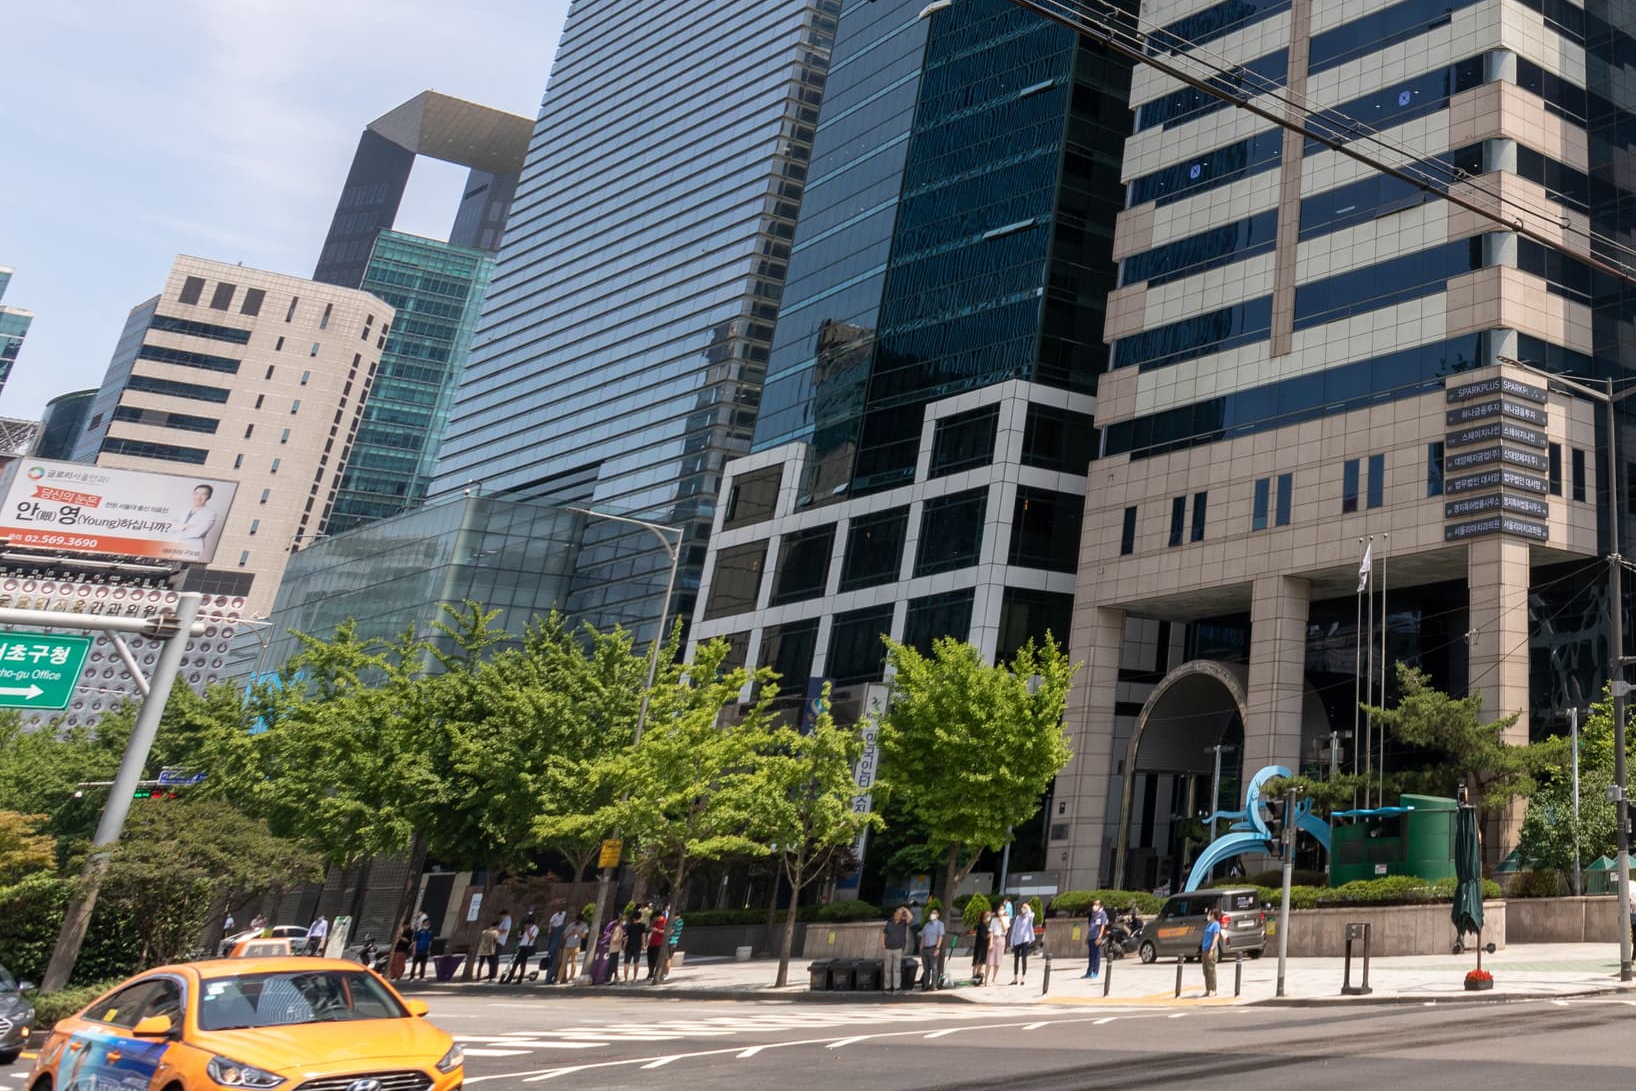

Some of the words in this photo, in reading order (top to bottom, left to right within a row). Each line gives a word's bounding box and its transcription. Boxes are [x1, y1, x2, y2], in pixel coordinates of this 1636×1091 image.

[1458, 380, 1501, 399] SPARKPLUS
[41, 488, 74, 502] 당신의
[76, 494, 98, 507] 눈은
[24, 534, 98, 548] 02.569.3690
[31, 669, 62, 681] Office
